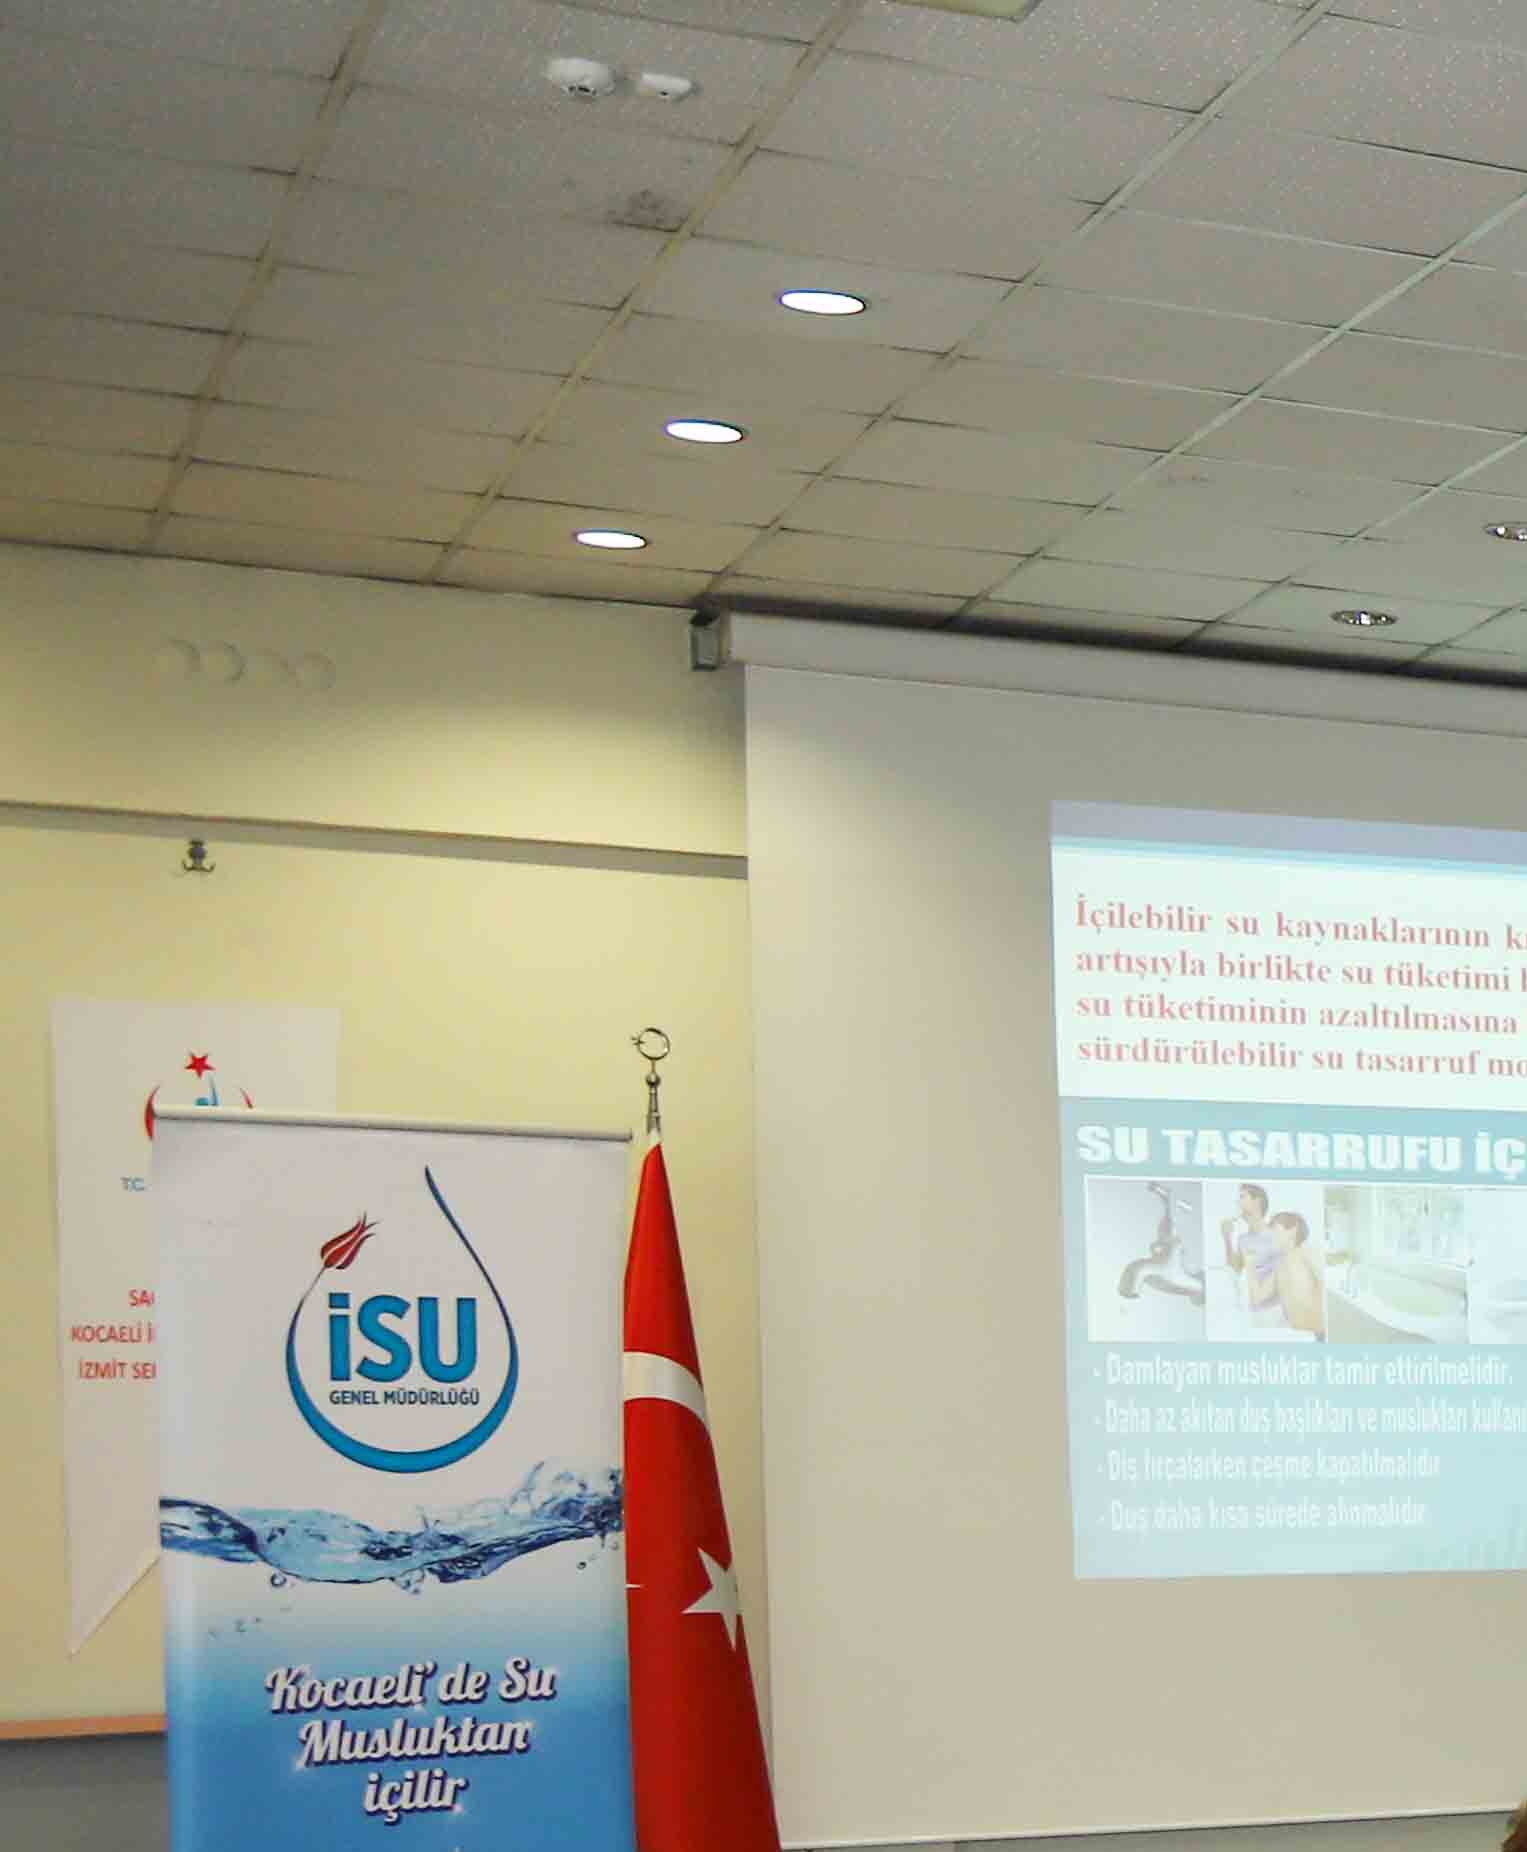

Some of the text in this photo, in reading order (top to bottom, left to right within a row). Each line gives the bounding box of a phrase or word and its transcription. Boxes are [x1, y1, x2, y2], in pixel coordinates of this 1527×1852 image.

[1075, 894, 1212, 934] İçilebilir
[1226, 913, 1260, 936] su
[1275, 911, 1491, 949] kaynaklarının
[1076, 949, 1206, 983] artışıyla
[1217, 952, 1332, 985] birlikte
[1342, 963, 1374, 985] su
[1384, 961, 1511, 994] tüketimi
[1076, 996, 1111, 1018] su
[1123, 993, 1308, 1026] tüketiminin
[1319, 1002, 1518, 1036] azaltılmasına
[1077, 1036, 1303, 1070] sürdürülebilir
[1312, 1050, 1344, 1072] su
[1355, 1048, 1481, 1076] tasarruf
[1076, 1125, 1151, 1164] SU
[1161, 1130, 1461, 1172] TASARRUFU
[128, 1289, 156, 1307] SA
[1105, 1353, 1210, 1392] Damlayan
[1217, 1355, 1320, 1386] musluklar
[1326, 1356, 1380, 1385] tamir
[329, 1386, 480, 1406] GENEL MÜDÜRLÜĞÜ
[499, 1656, 558, 1701] Su
[298, 1716, 533, 1768] Musluktan
[363, 1767, 470, 1827] içilir
